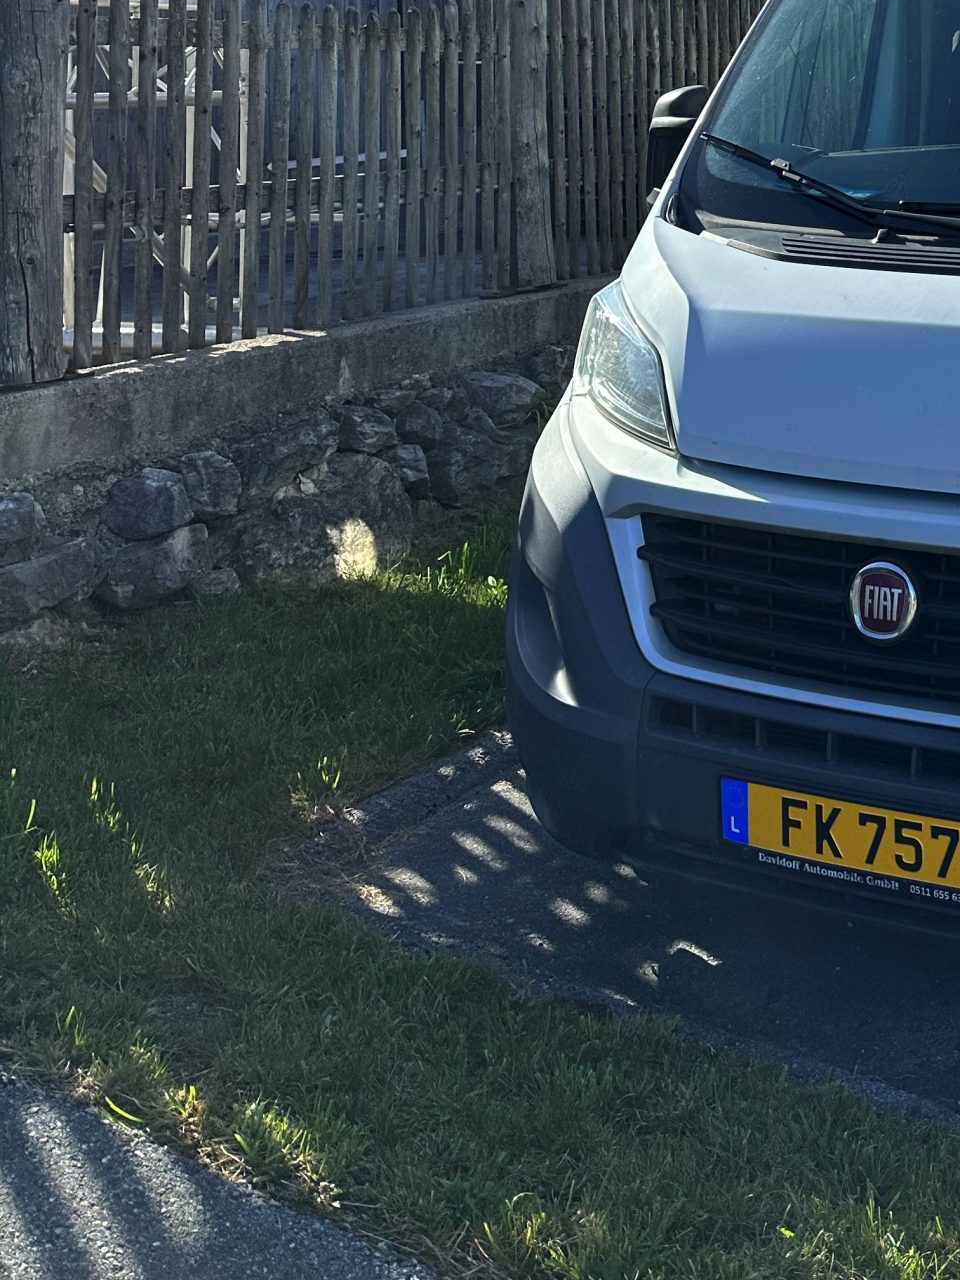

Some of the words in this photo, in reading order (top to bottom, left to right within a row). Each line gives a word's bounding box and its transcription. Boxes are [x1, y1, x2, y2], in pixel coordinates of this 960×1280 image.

[864, 585, 903, 622] FIAT
[731, 815, 740, 833] L
[758, 852, 800, 870] Davidoff
[803, 863, 864, 884] Automobile
[909, 884, 931, 897] 0511
[933, 889, 950, 900] 655
